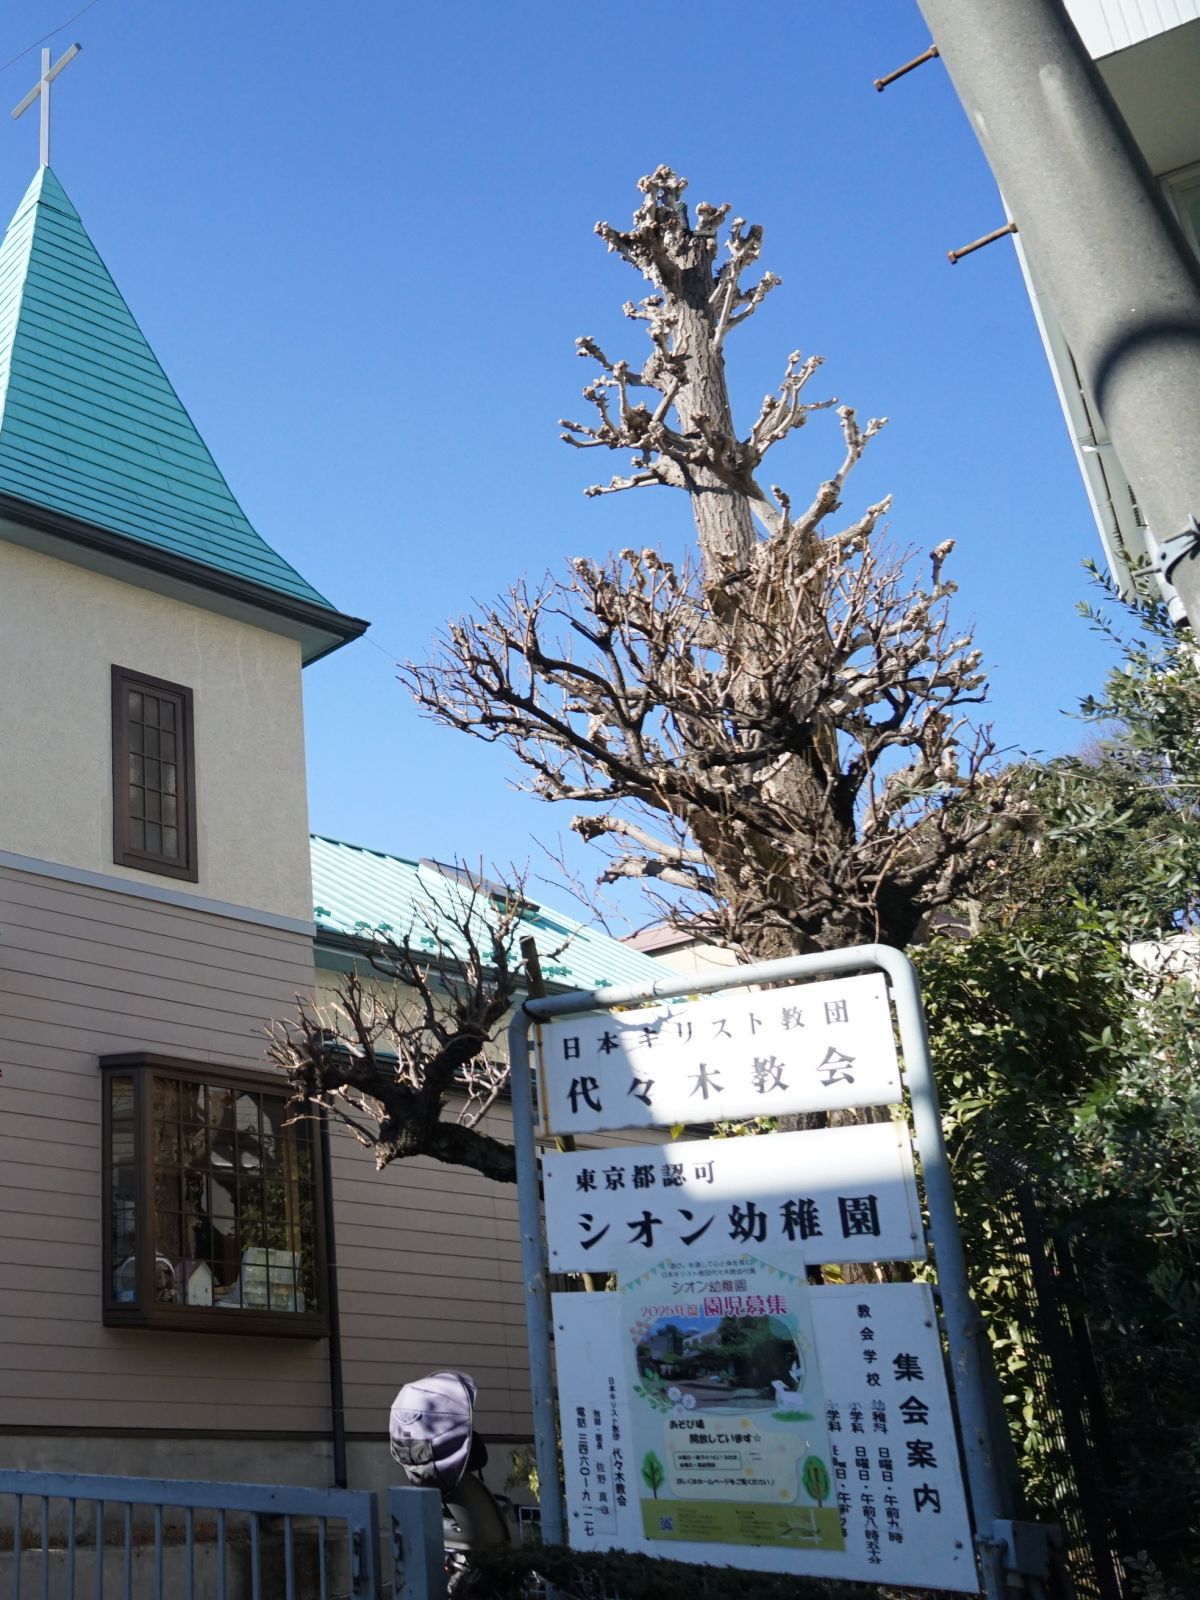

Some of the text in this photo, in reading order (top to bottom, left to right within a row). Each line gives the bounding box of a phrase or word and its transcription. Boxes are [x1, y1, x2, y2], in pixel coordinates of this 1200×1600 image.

[563, 999, 850, 1060] 日本キリスト教団
[567, 1045, 856, 1114] 代々木教会
[575, 1158, 717, 1193] 東京都認可
[576, 1193, 882, 1250] シオン幼稚園
[640, 1294, 788, 1319] 2025年度 園児募集
[671, 1279, 748, 1295] シオン幼稚園
[856, 1303, 882, 1388] 教会学校
[576, 1406, 587, 1429] 電話
[668, 1419, 705, 1430] あそび場
[892, 1352, 941, 1514] 集会案内
[613, 1448, 627, 1507] 代々木教会
